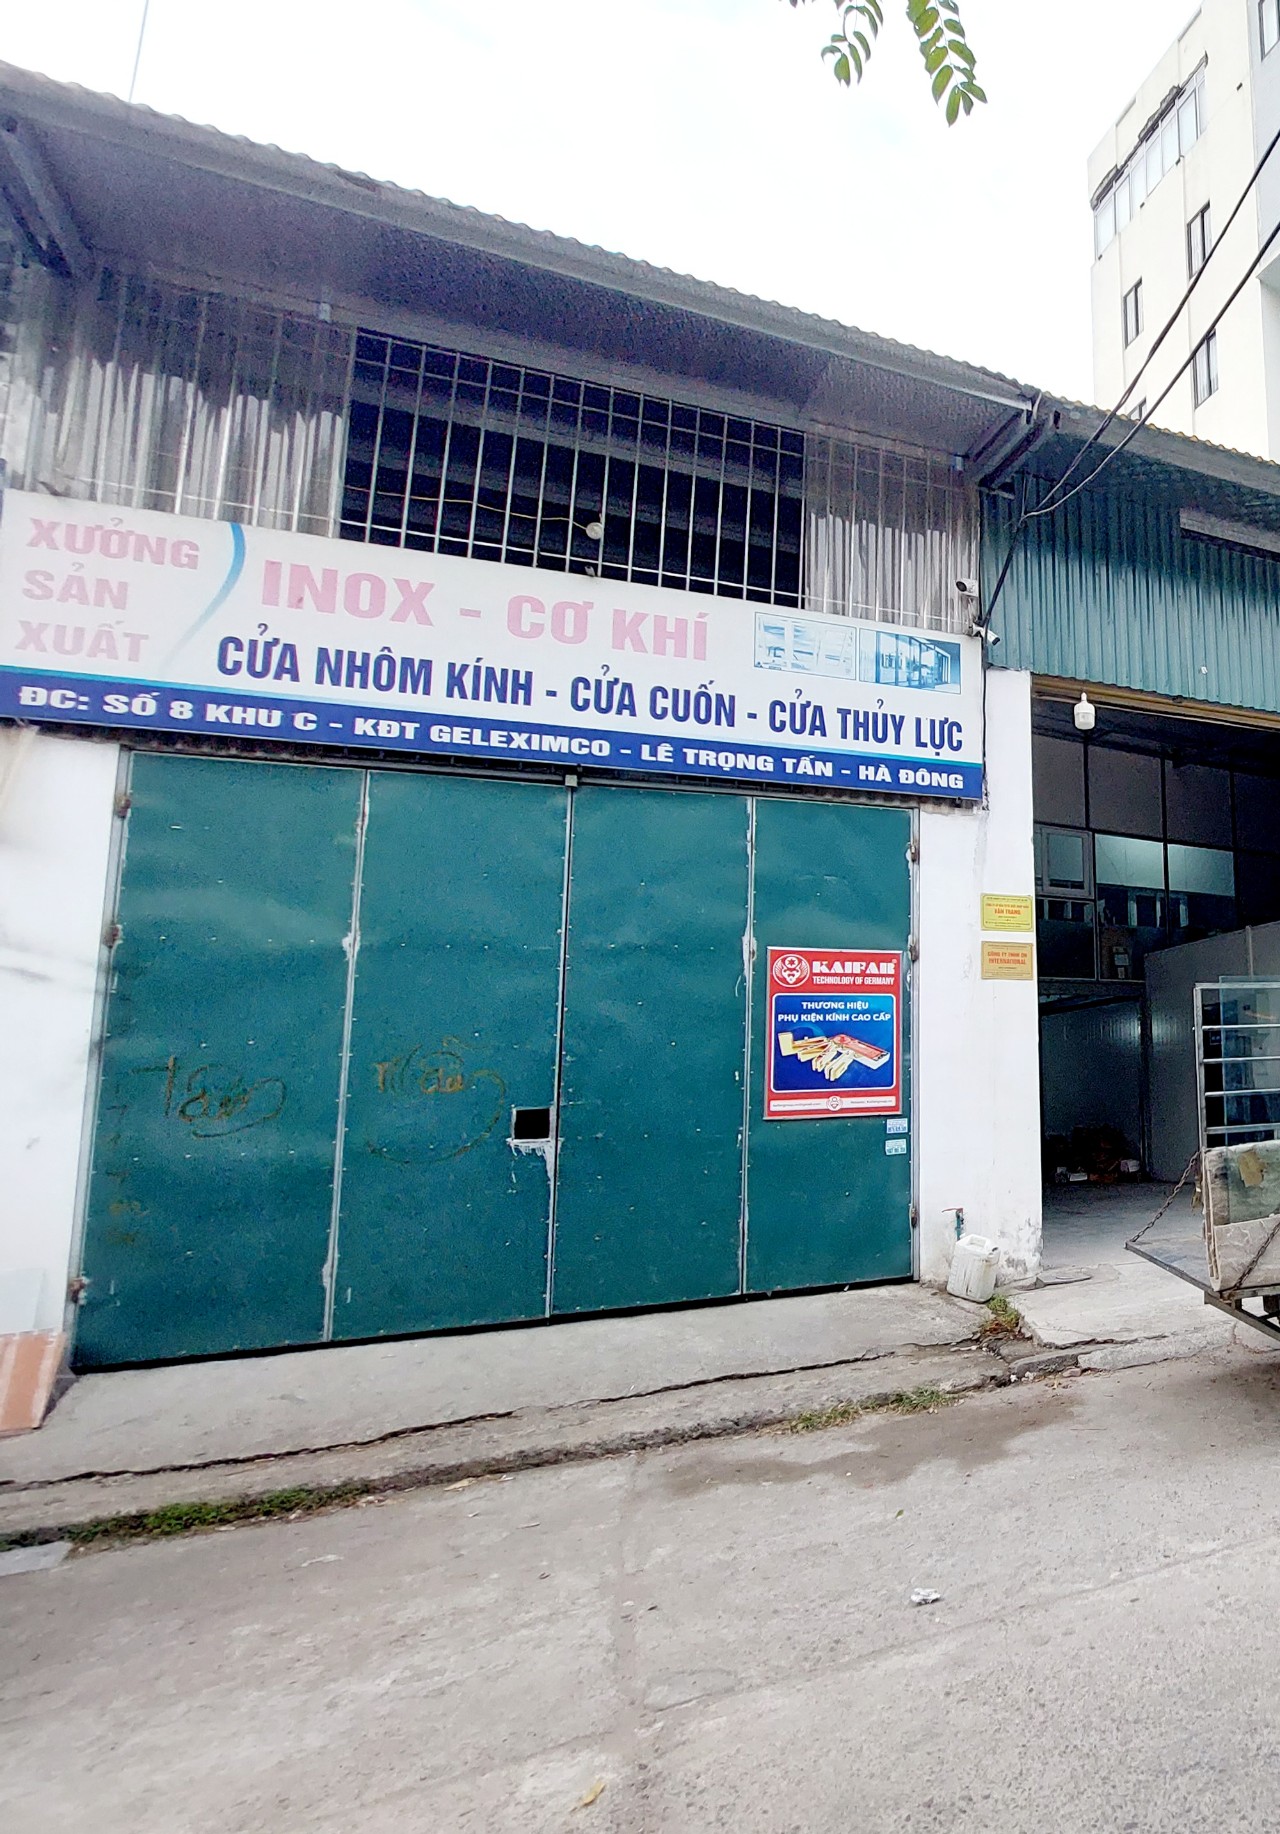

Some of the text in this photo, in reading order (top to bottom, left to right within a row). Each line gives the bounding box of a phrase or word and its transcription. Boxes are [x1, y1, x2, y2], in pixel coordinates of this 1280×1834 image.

[26, 516, 200, 571] XƯỞNG
[22, 562, 129, 611] SẢN
[261, 560, 436, 627] INOX
[506, 594, 594, 645] CƠ
[611, 607, 710, 661] KHÍ
[14, 620, 150, 663] XUẤT
[217, 623, 301, 683] CỬA
[315, 646, 432, 696] NHÔM
[446, 656, 532, 707] KÍNH
[570, 664, 637, 718] CỬA
[649, 679, 736, 728] CUỐN
[769, 689, 827, 738] CỬA
[836, 698, 905, 746] THỦY
[915, 716, 963, 758] LỰC
[19, 686, 89, 711] ĐC:
[103, 691, 161, 717] SỐ
[169, 701, 193, 720] 8
[205, 704, 283, 728] KHU
[293, 710, 318, 731] C
[354, 718, 420, 741] KĐT
[429, 726, 611, 757] GELEXIMCO
[641, 738, 674, 763] LÊ
[683, 748, 774, 774] TRỌNG
[782, 754, 833, 777] TẤN
[859, 761, 892, 783] HÀ
[899, 767, 964, 790] ĐÔNG
[801, 1000, 869, 1011] THƯƠNG HIỆU
[812, 976, 895, 986] TECHNOLOGY OF GERMANY
[777, 1011, 892, 1023] PHỤ KIỆN KÍNH CAO CẤP
